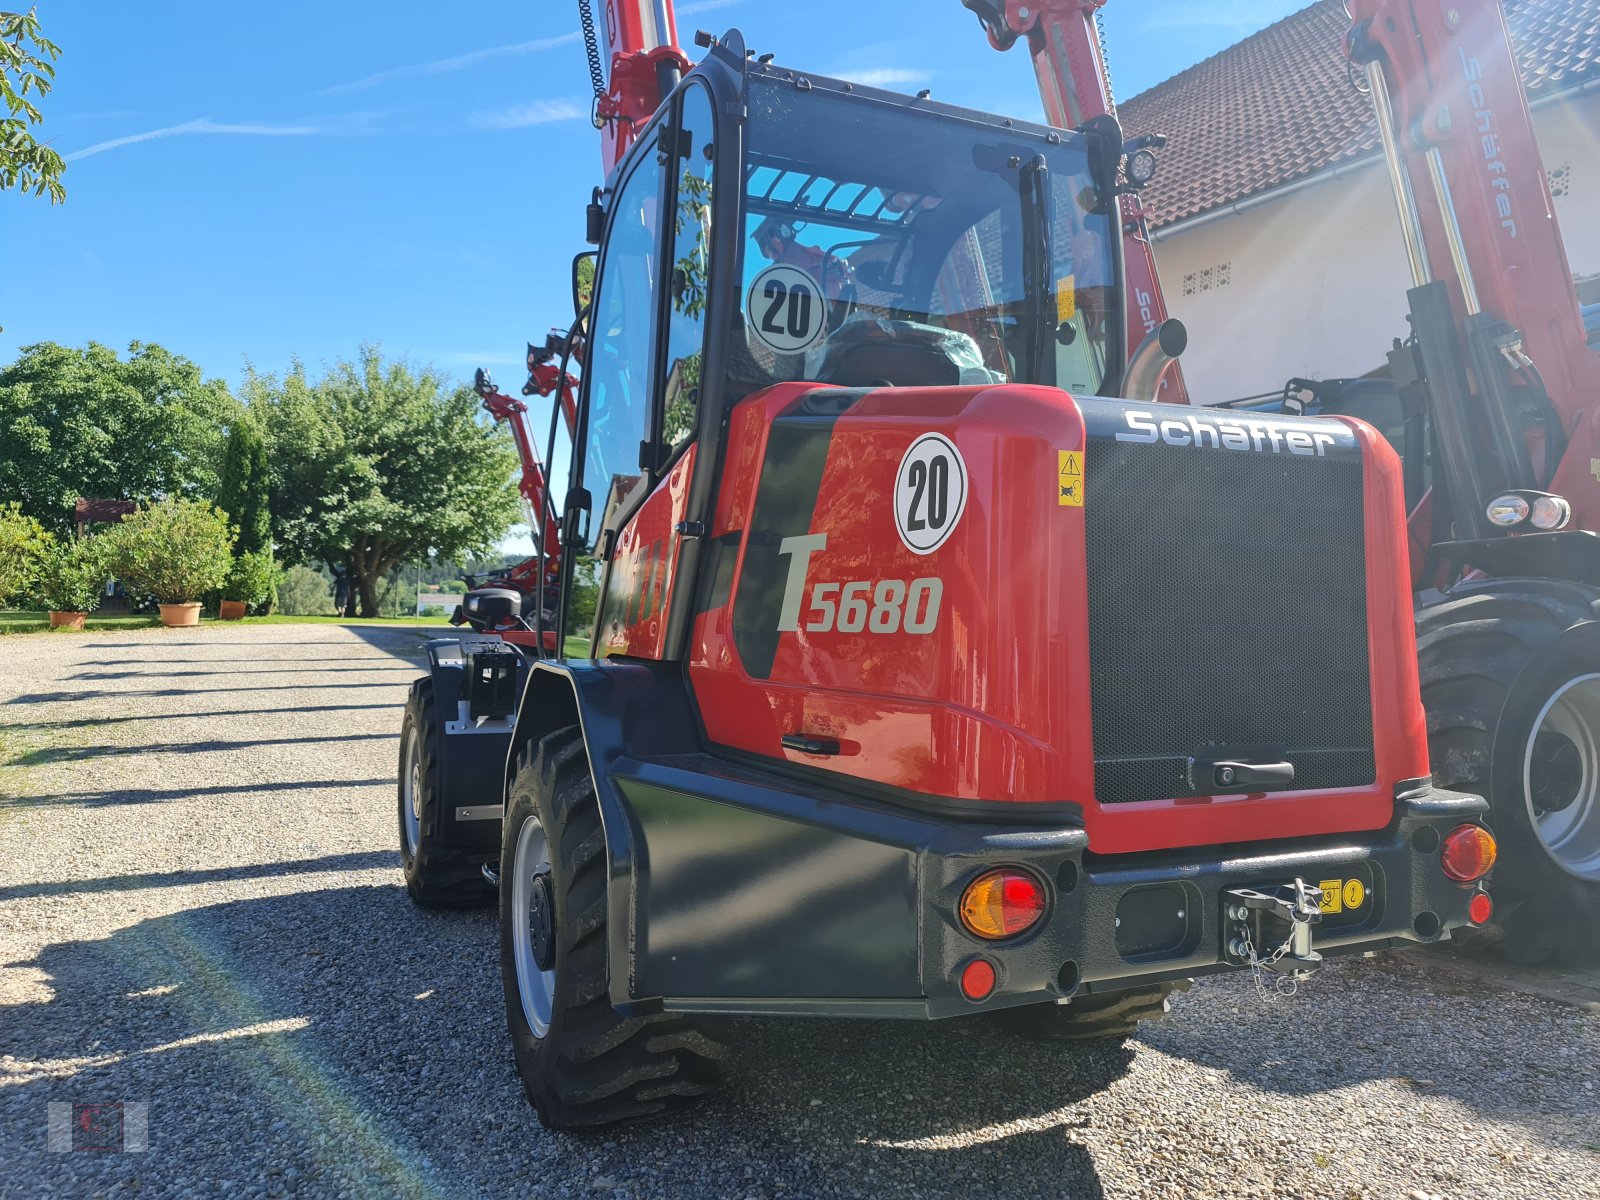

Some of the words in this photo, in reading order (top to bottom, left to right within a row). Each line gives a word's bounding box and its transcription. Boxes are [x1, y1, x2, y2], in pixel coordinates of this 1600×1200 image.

[1459, 47, 1517, 238] Schäffer
[762, 279, 811, 338] 20
[907, 454, 949, 532] 20
